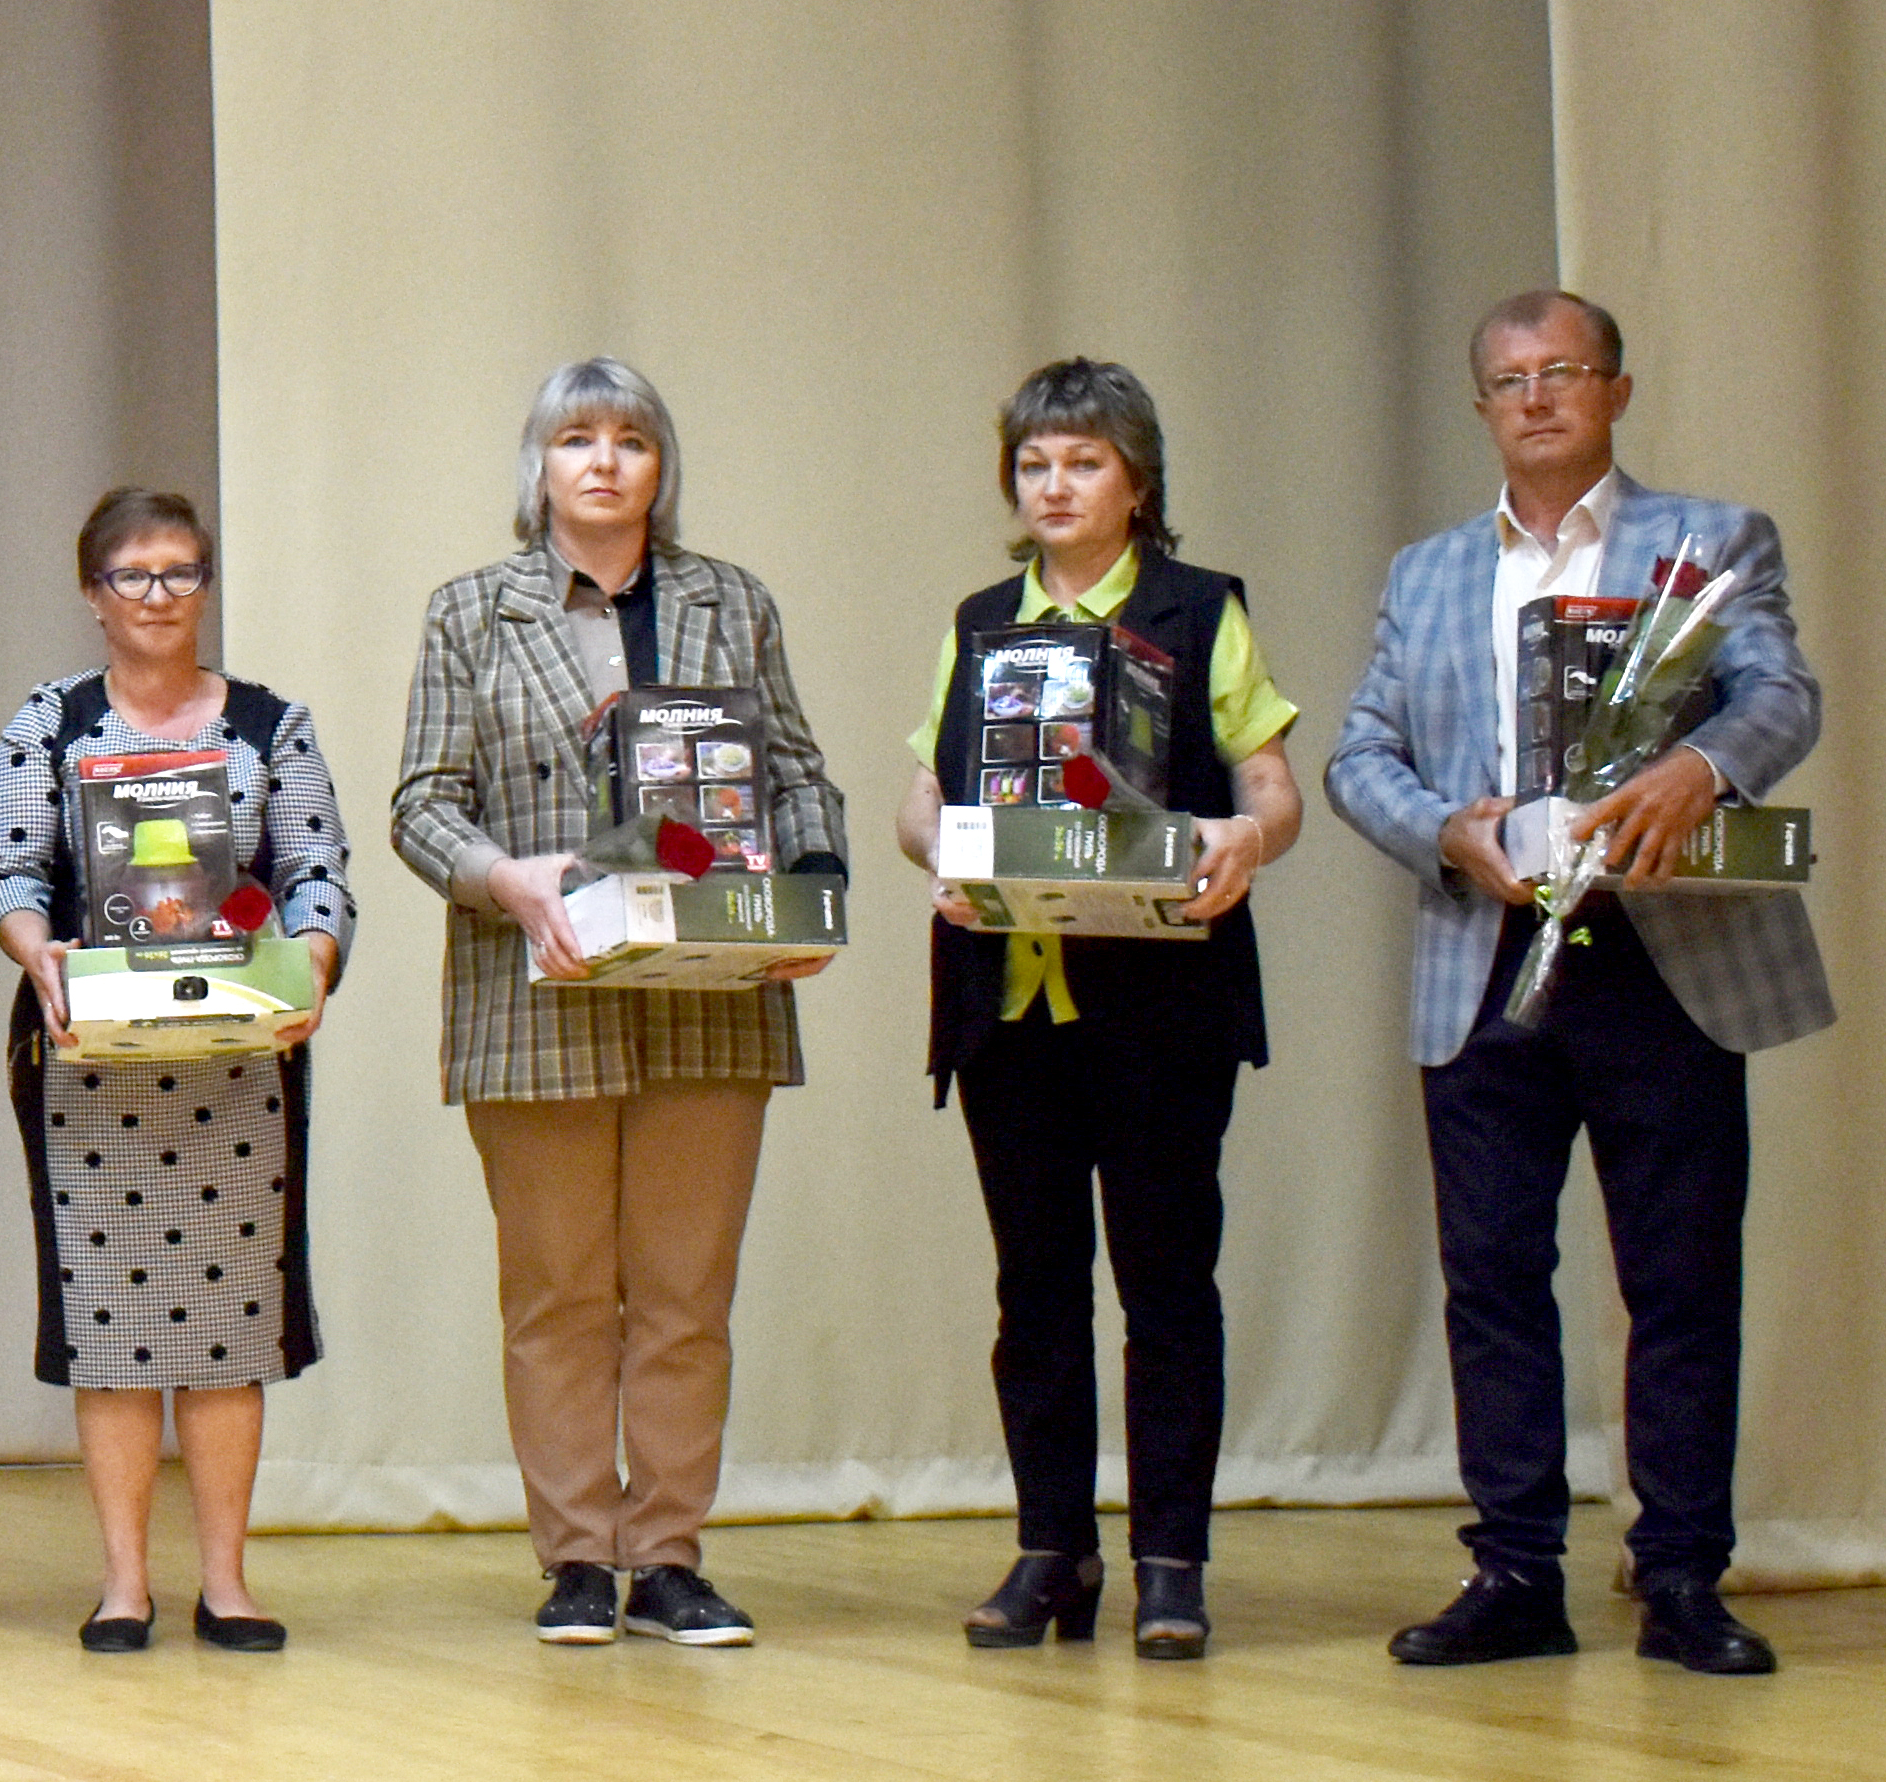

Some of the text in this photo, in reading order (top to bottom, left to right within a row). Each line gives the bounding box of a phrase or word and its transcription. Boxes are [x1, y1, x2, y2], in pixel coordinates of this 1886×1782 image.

[994, 645, 1076, 663] МОЛНИЯ
[639, 707, 725, 724] МОЛНИЯ
[113, 781, 200, 799] МОЛНИЯ
[746, 854, 767, 866] TV
[137, 921, 146, 931] 2
